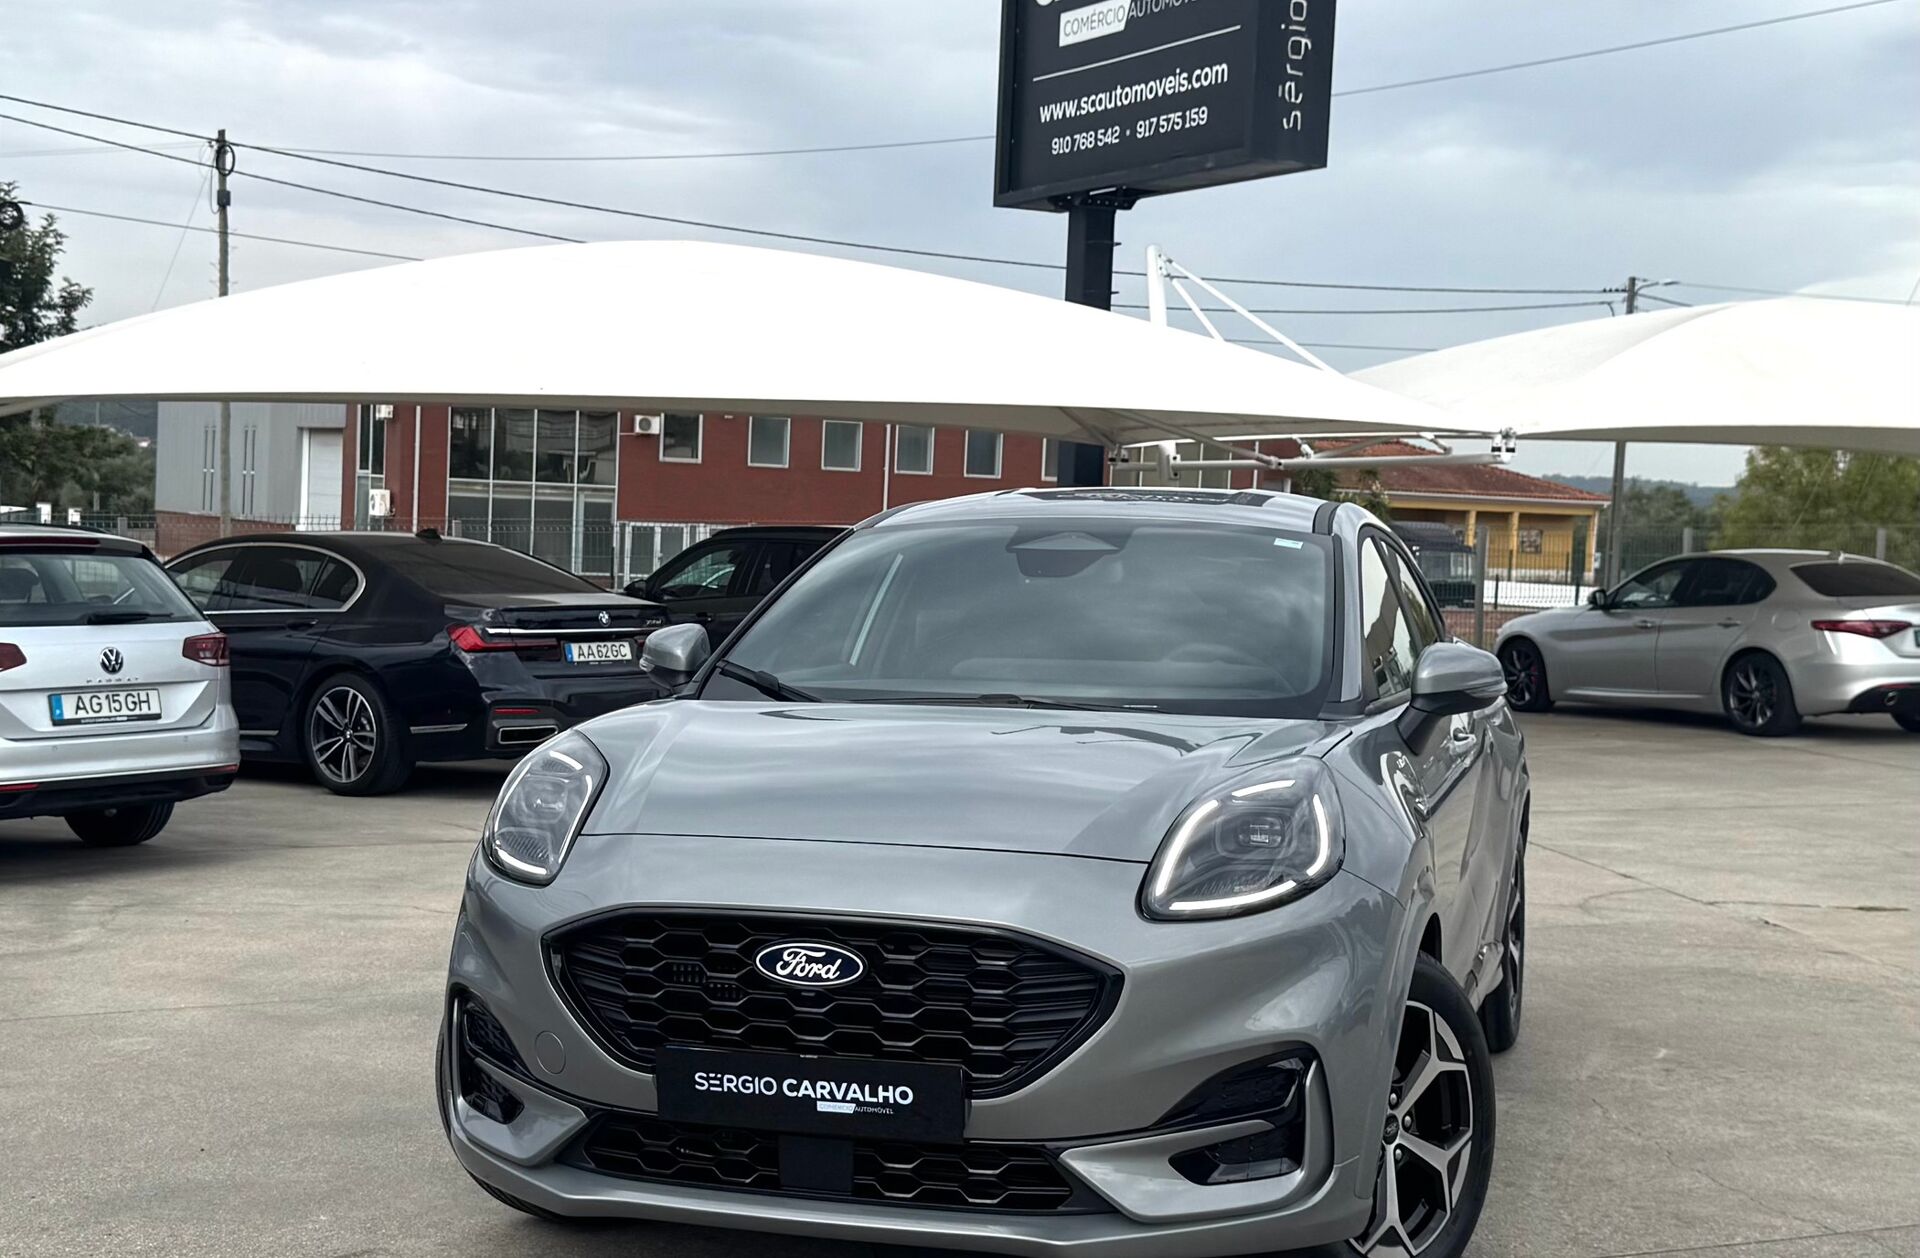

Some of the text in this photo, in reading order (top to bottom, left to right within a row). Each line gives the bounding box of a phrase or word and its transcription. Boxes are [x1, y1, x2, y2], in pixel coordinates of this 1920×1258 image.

[1063, 5, 1126, 37] COMÉRCIO
[1039, 63, 1228, 123] www.scautomoveis.com
[1051, 106, 1208, 155] 910 768 542 917 575 159
[776, 948, 842, 979] Ford
[782, 1078, 914, 1105] CARVALHO
